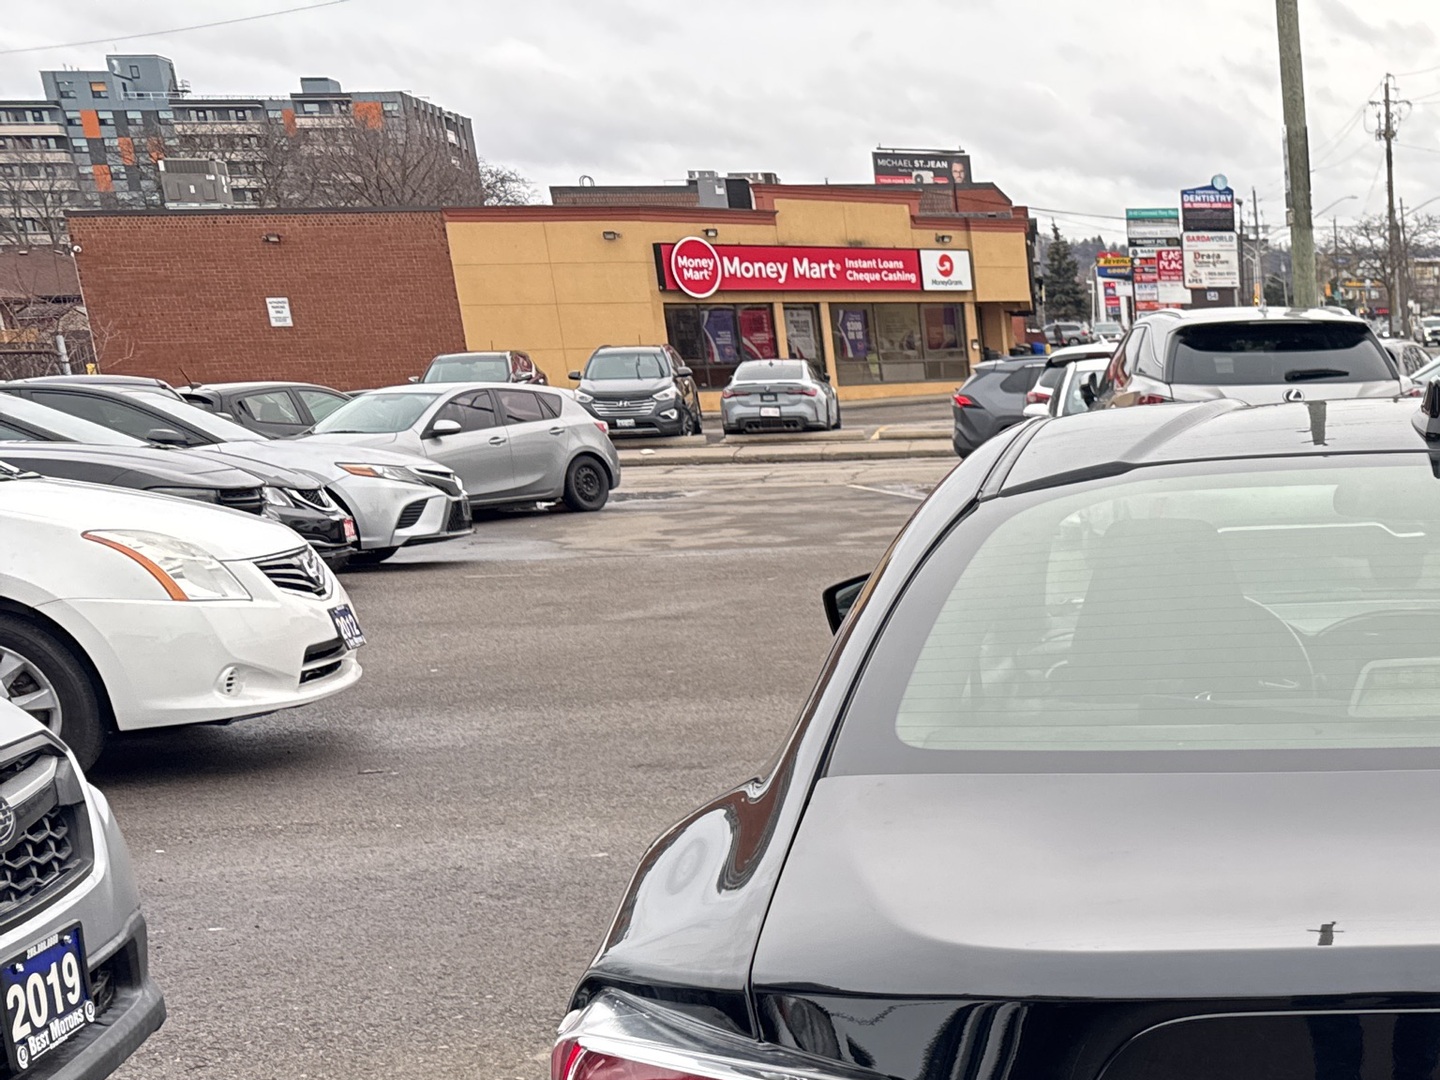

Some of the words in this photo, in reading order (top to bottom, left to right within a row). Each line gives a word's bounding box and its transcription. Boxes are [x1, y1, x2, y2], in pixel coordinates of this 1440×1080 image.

[877, 159, 912, 168] MICHAEL
[1183, 194, 1232, 203] DENTISTRY
[1186, 235, 1234, 243] GARDAWORLD
[1161, 251, 1182, 259] EAS
[678, 255, 714, 270] Money
[845, 257, 877, 269] Instant
[879, 258, 904, 269] Loans
[1159, 261, 1182, 270] PLAC
[683, 268, 712, 281] Mart
[723, 256, 788, 283] Money
[793, 257, 838, 279] Mart
[846, 270, 880, 283] Cheque
[881, 270, 916, 283] Cashing
[931, 279, 963, 287] MoneyGram
[335, 614, 360, 639] 2012
[6, 952, 81, 1043] 2019
[27, 1030, 50, 1057] BEST
[49, 1008, 85, 1041] MOTORS
